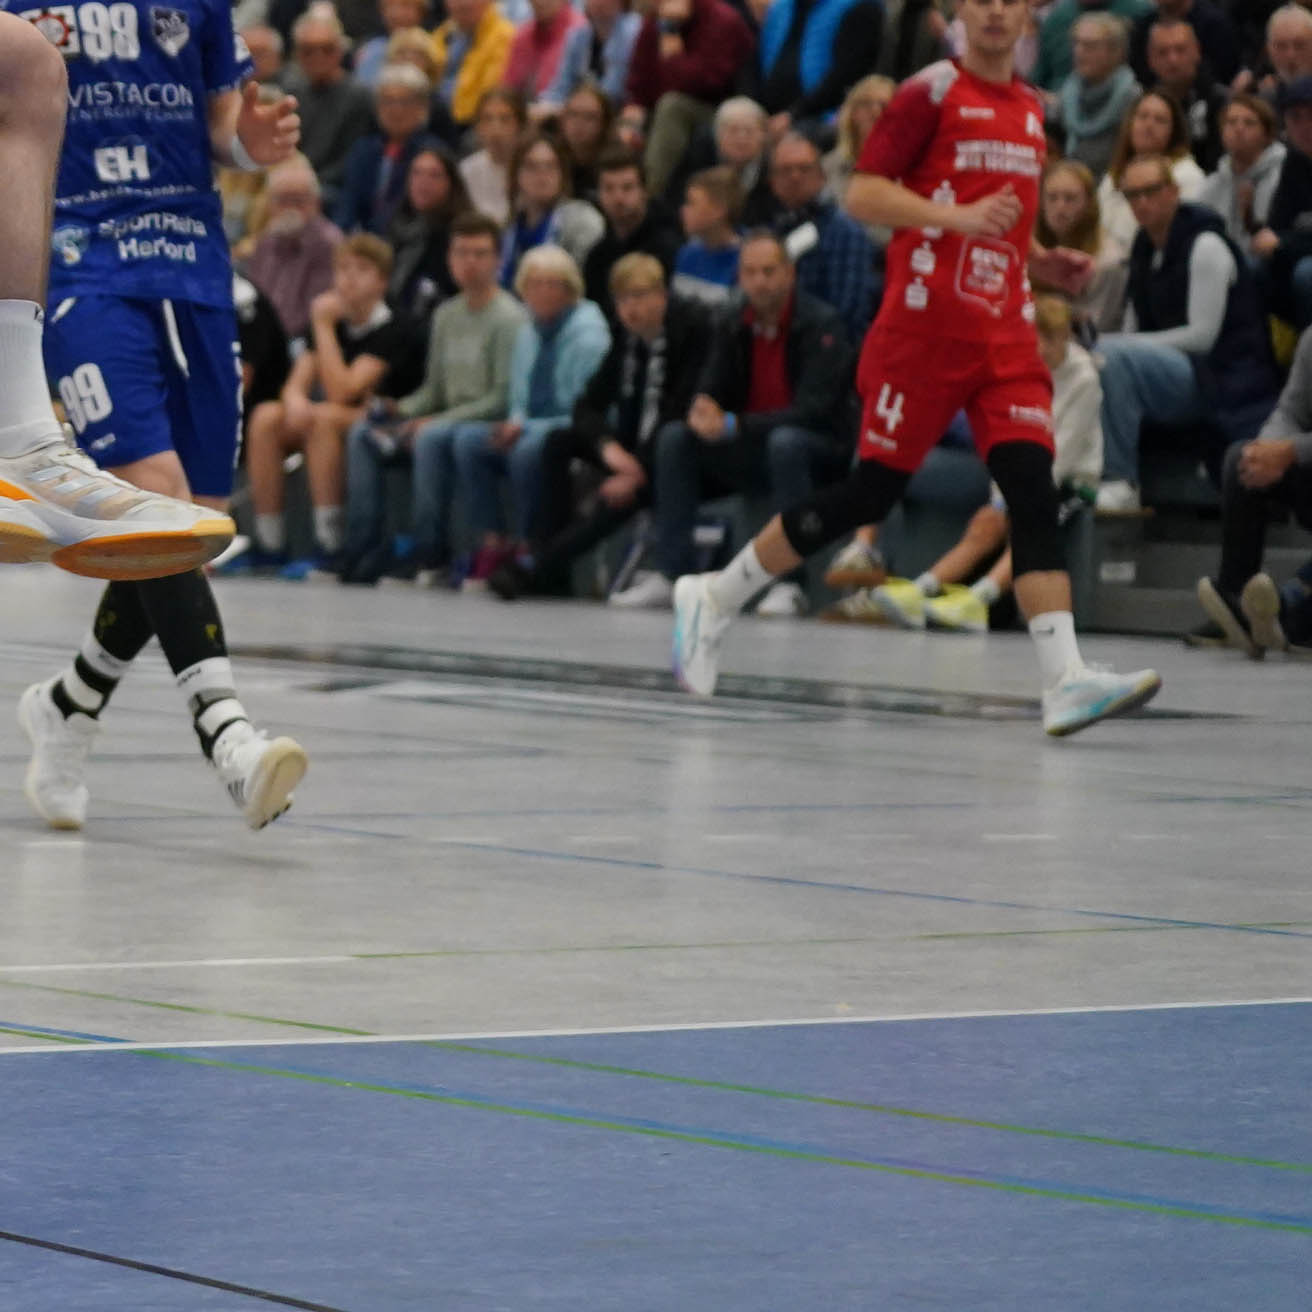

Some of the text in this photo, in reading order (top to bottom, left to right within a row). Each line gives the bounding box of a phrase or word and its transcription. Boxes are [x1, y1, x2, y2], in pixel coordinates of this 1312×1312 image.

[94, 144, 151, 182] EH
[117, 236, 197, 264] Herford
[876, 383, 905, 433] 4
